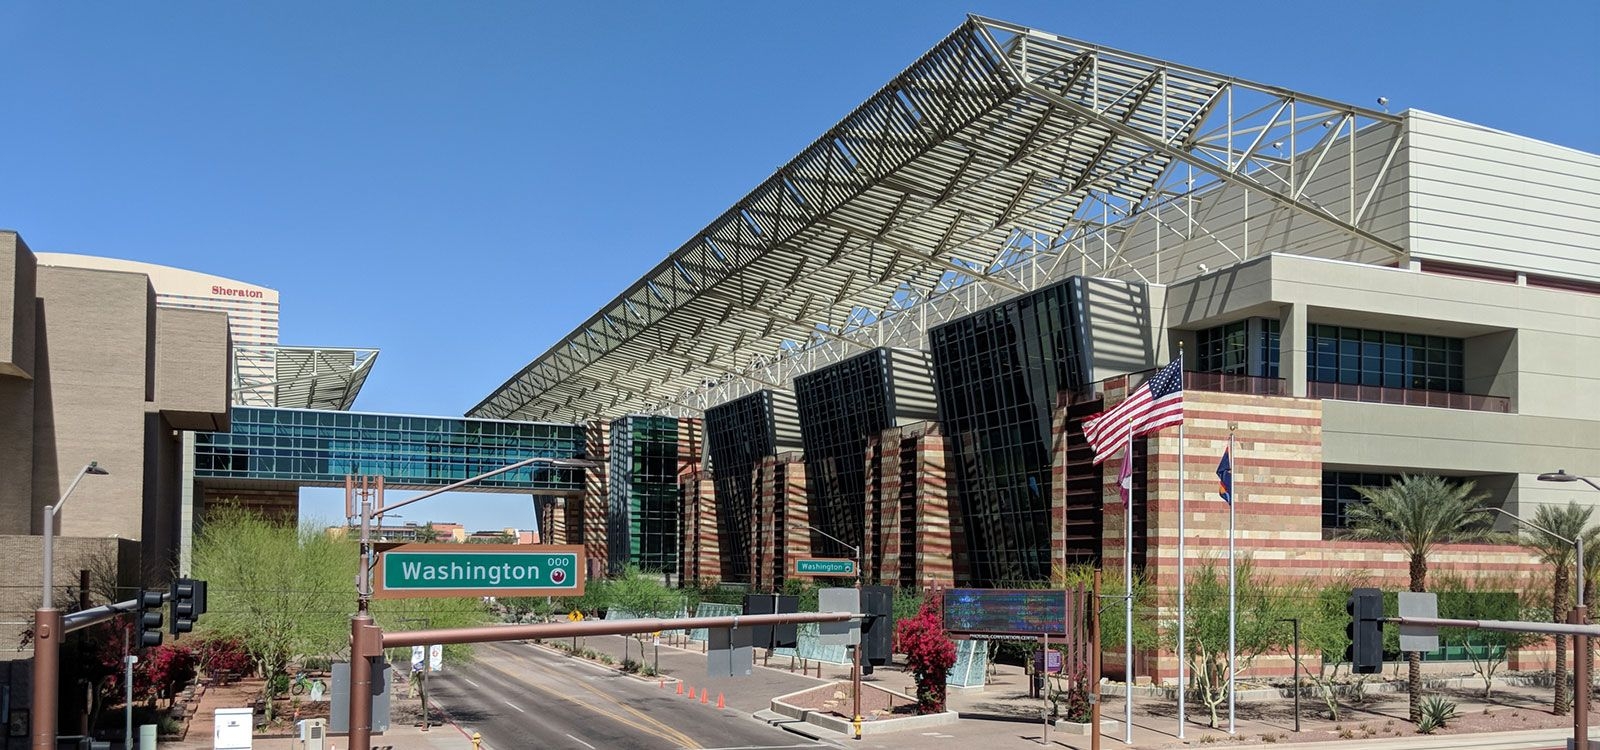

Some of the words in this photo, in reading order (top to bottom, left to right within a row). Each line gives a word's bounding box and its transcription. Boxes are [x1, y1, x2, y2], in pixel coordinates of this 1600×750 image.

[211, 285, 263, 298] Sheraton
[402, 561, 540, 584] Washington
[802, 562, 843, 571] Washington
